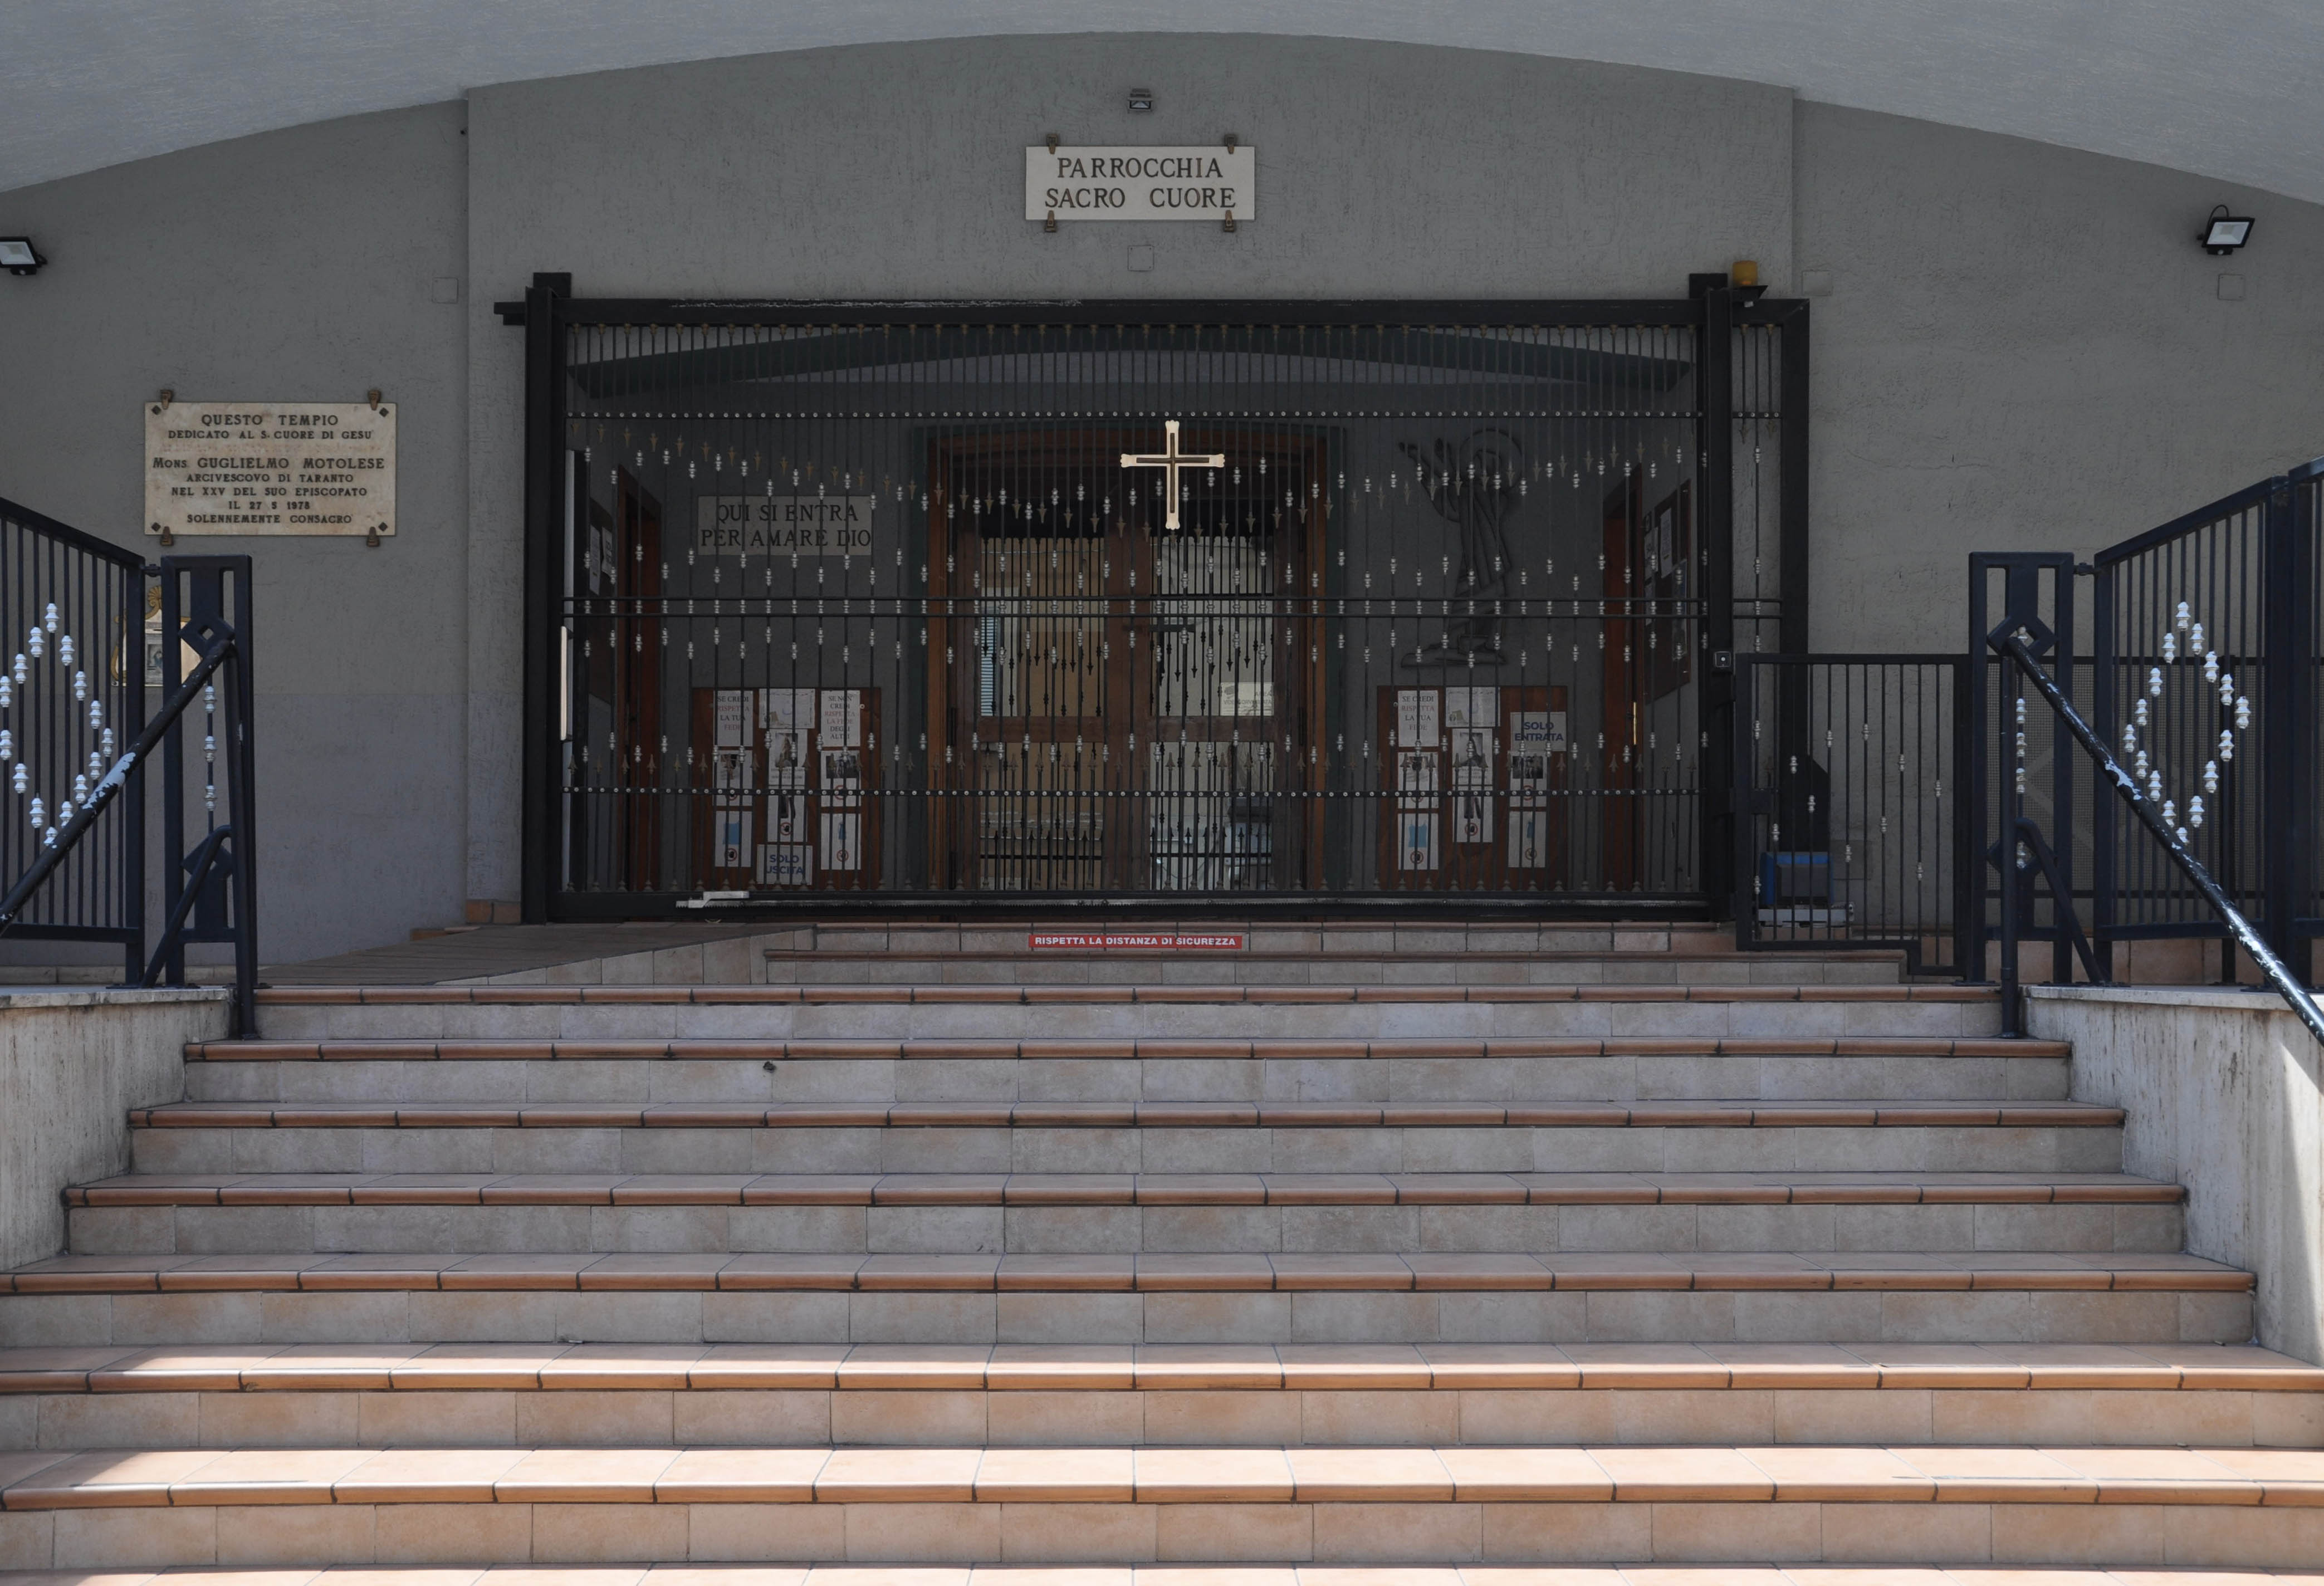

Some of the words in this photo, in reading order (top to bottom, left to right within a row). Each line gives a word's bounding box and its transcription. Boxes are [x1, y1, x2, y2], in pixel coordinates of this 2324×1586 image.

[1057, 158, 1223, 178] PARROCCHIA
[1045, 188, 1126, 208] SACRO
[1149, 188, 1236, 208] CUORE
[202, 414, 262, 427] QUESTO
[278, 415, 338, 425] TEMPIO
[168, 430, 229, 439] DEDICATO
[239, 430, 254, 439] AL
[274, 430, 315, 439] CUORE
[321, 430, 334, 439] DI
[197, 457, 289, 468] GUGLIELMO
[304, 458, 384, 468] MOTOLESE
[299, 474, 354, 482] TARANTO
[172, 487, 194, 496] NEL
[202, 487, 226, 496] XXV
[233, 487, 256, 496] DEL
[228, 501, 240, 509] IL
[287, 501, 310, 510] 1978
[187, 515, 280, 523] SOLENNEMENTE
[717, 505, 750, 524] QUI
[759, 505, 777, 521] SI
[785, 505, 858, 521] ENTRA
[701, 530, 741, 546] PER
[750, 530, 828, 546] AMARE
[836, 530, 870, 546] DIO
[1523, 722, 1554, 730] SOLO
[1514, 733, 1564, 741] ENTRATA
[770, 854, 799, 863] SOLO
[1176, 937, 1236, 946] SICUREZZA
